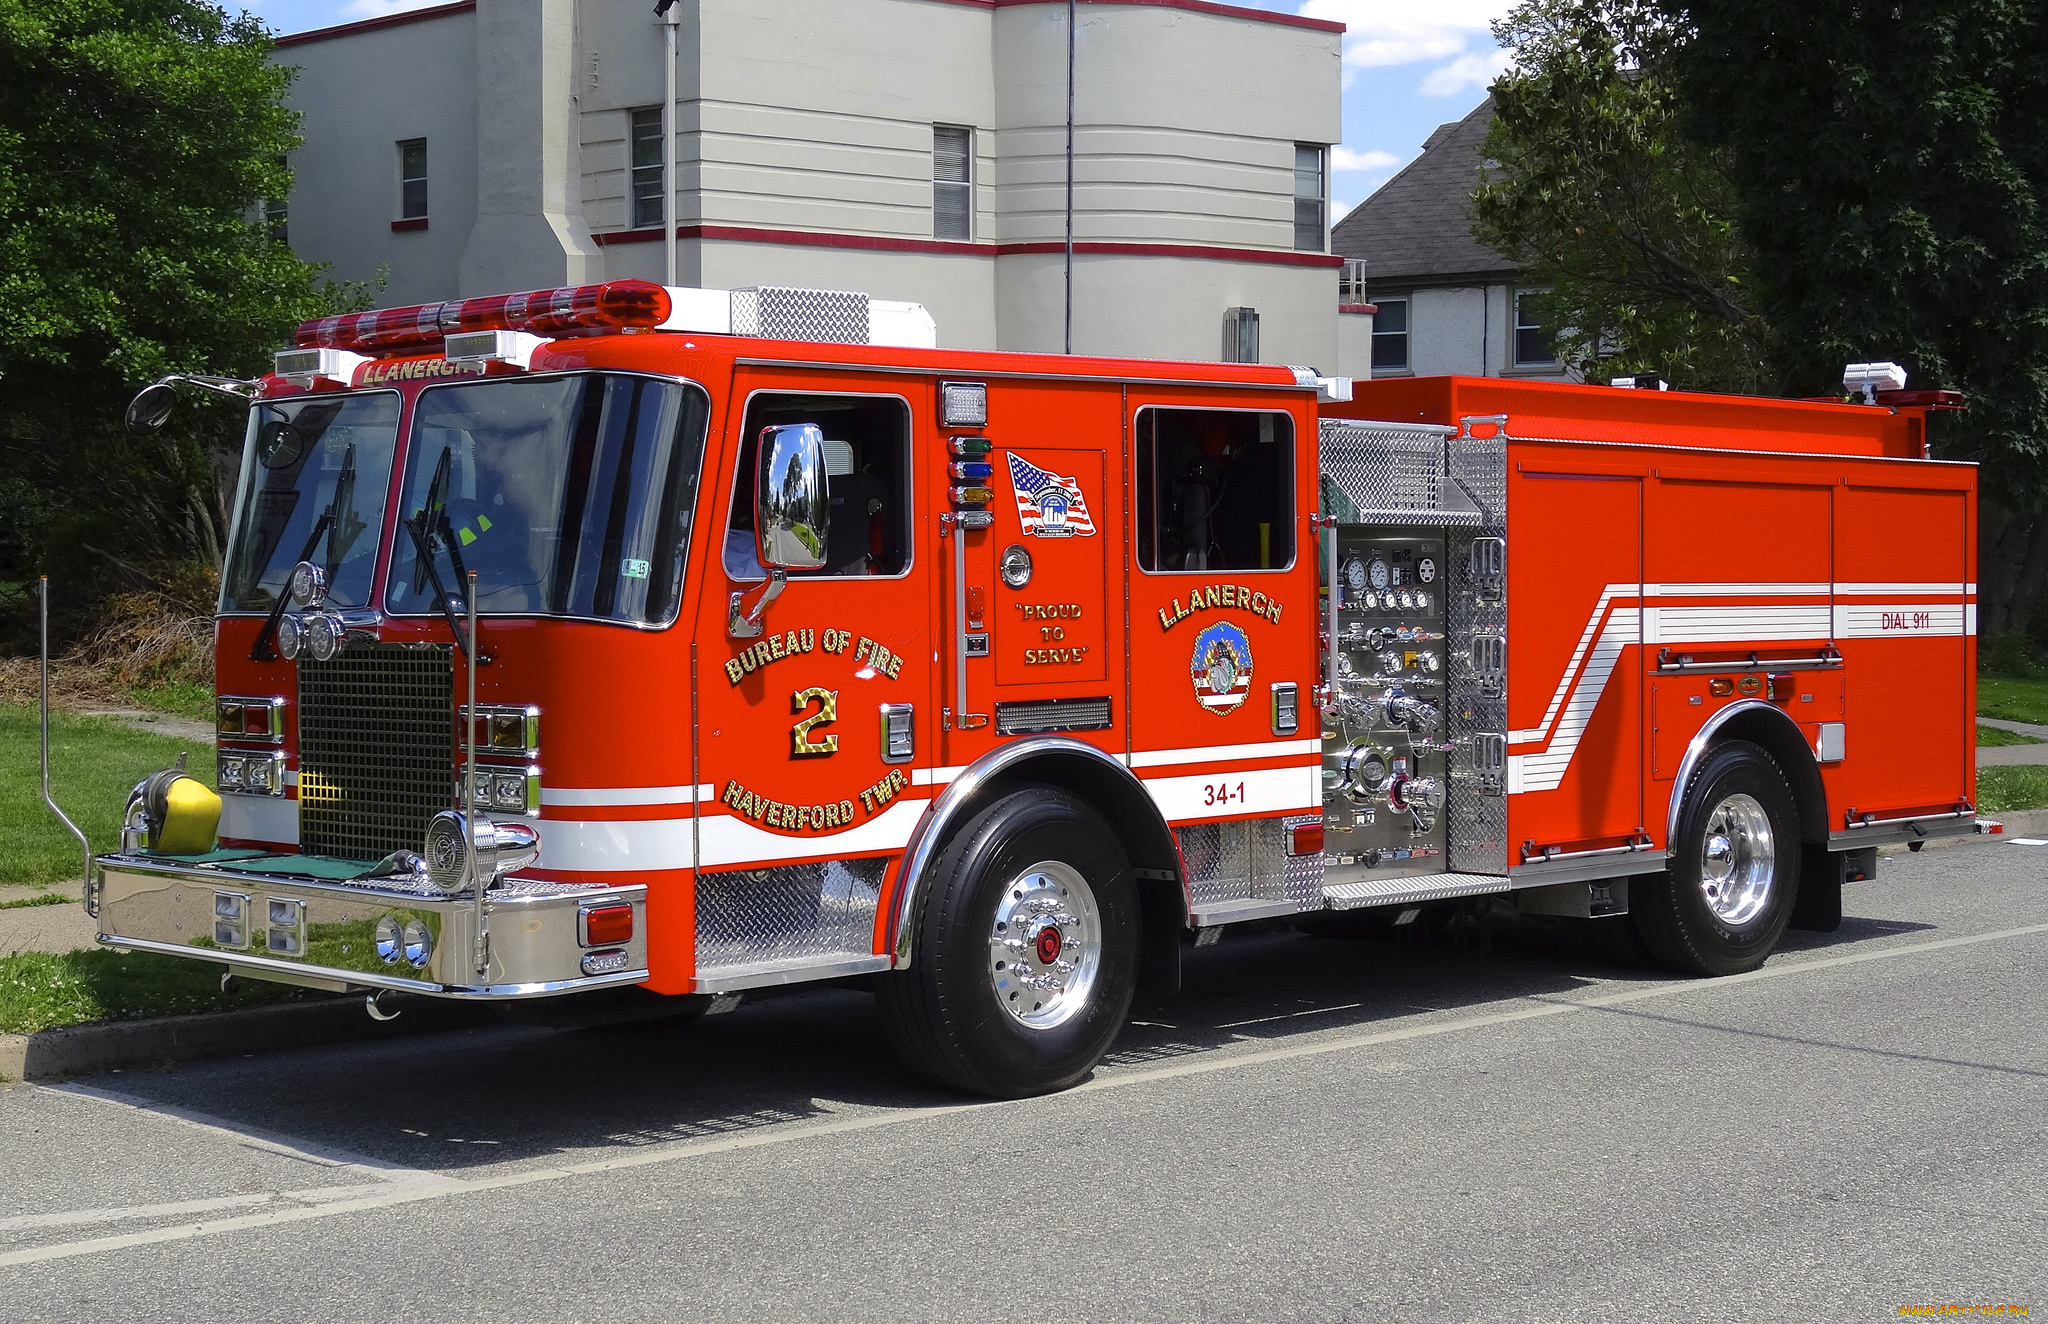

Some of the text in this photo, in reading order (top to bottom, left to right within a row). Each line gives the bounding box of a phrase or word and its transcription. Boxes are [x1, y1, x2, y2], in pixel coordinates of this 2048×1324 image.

[1158, 584, 1283, 629] LLANERCH
[1882, 612, 1929, 629] DIAL 911
[724, 628, 904, 684] BUREAU OF FIRE
[1041, 626, 1065, 641] TO
[793, 687, 838, 754] 2
[723, 768, 908, 829] HAVERFORD TWP.
[1204, 782, 1245, 806] 34-1
